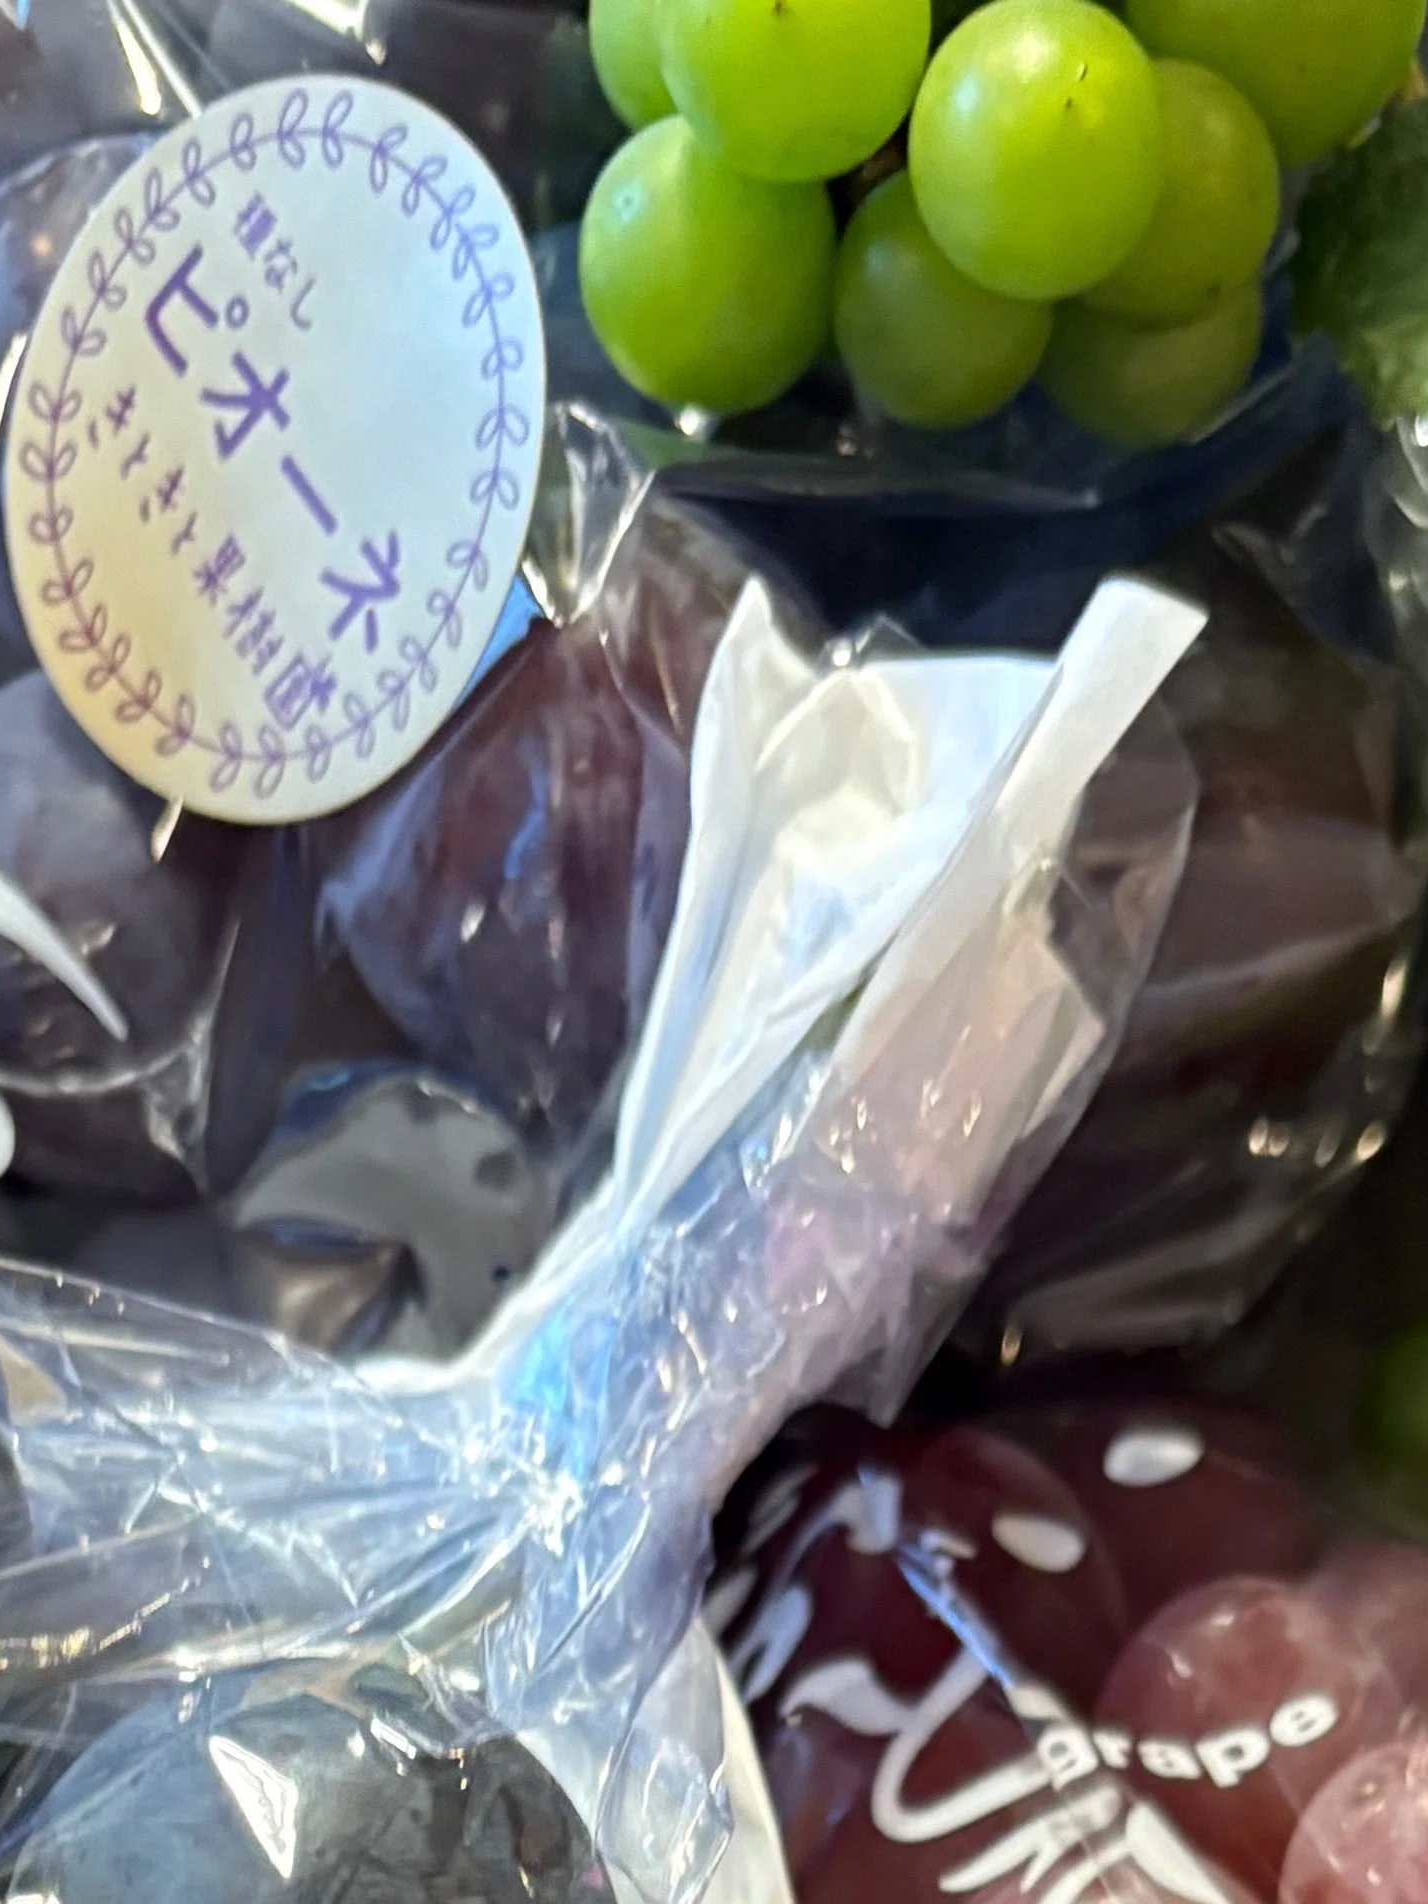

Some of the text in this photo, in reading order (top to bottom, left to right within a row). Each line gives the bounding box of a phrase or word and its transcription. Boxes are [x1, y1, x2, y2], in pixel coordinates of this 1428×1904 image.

[232, 191, 314, 331] 種なし
[84, 385, 339, 731] きときと果樹園
[144, 244, 403, 653] ピオーネ
